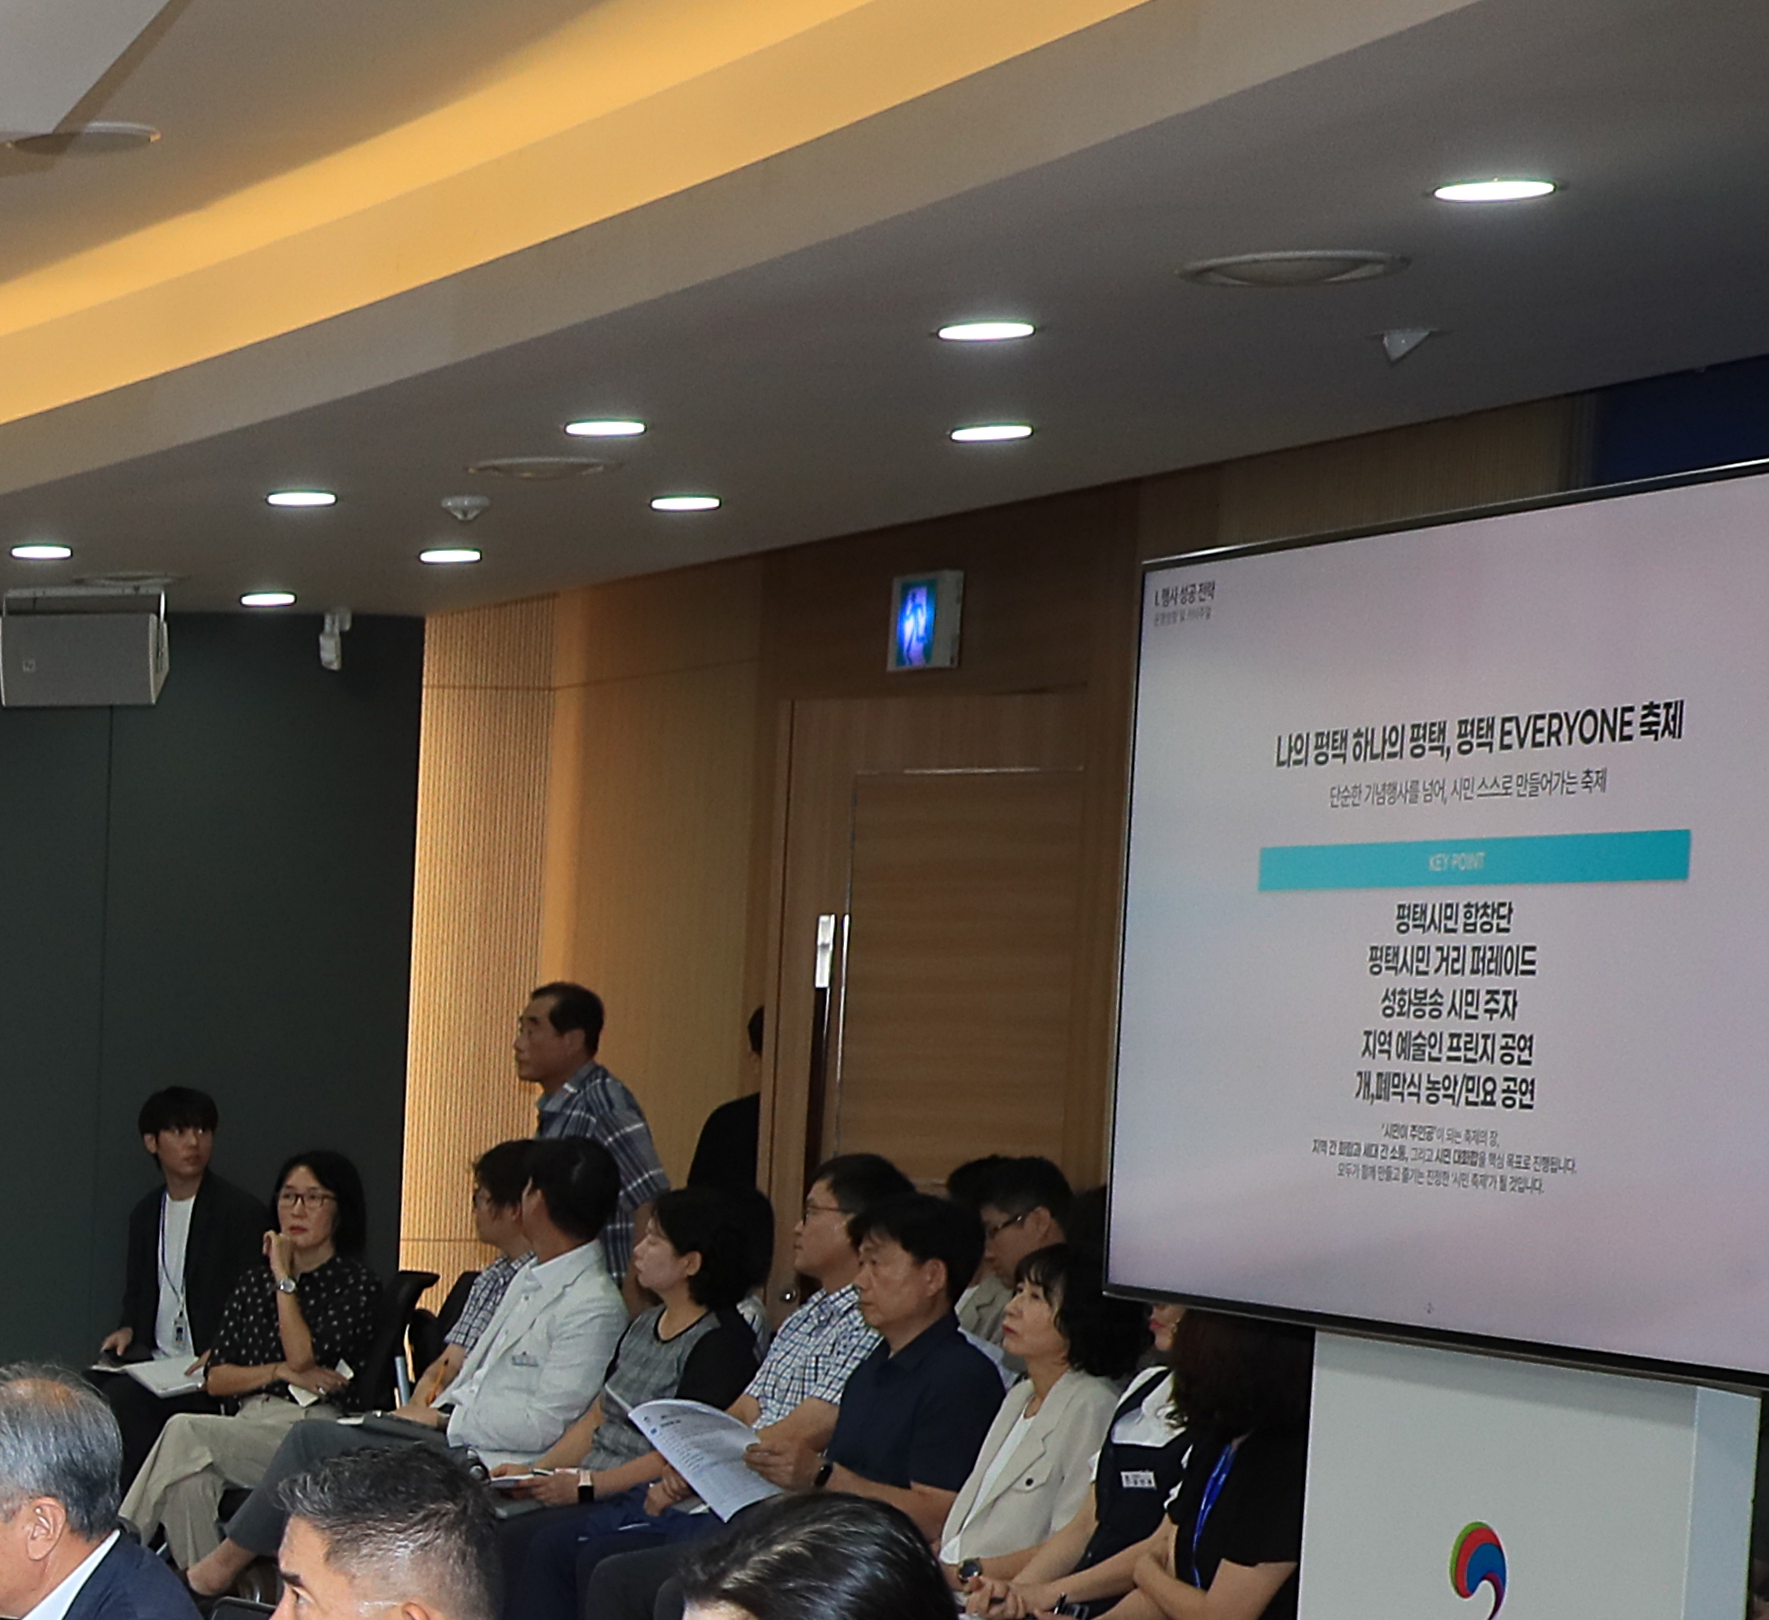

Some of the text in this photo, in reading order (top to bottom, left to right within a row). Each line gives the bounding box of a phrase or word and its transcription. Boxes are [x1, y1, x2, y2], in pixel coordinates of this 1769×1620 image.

[1276, 699, 1685, 768] 나의 평택 하나의 평택, 평택 EVERYONE 축제
[1330, 767, 1607, 809] 단순한 기념행사를 넘어, 시민 스스로 만들어가는 축제
[1428, 851, 1486, 871] KEY POINT
[1396, 901, 1514, 934] 평택시민 합창단
[1368, 944, 1537, 977] 평택시민 거리 퍼레이드
[1381, 987, 1518, 1021] 성화봉송 시민 주자
[1362, 1029, 1534, 1066] 지역 예술인 프린지 공연
[1355, 1070, 1536, 1110] 개,폐막식 농악/민요 공연
